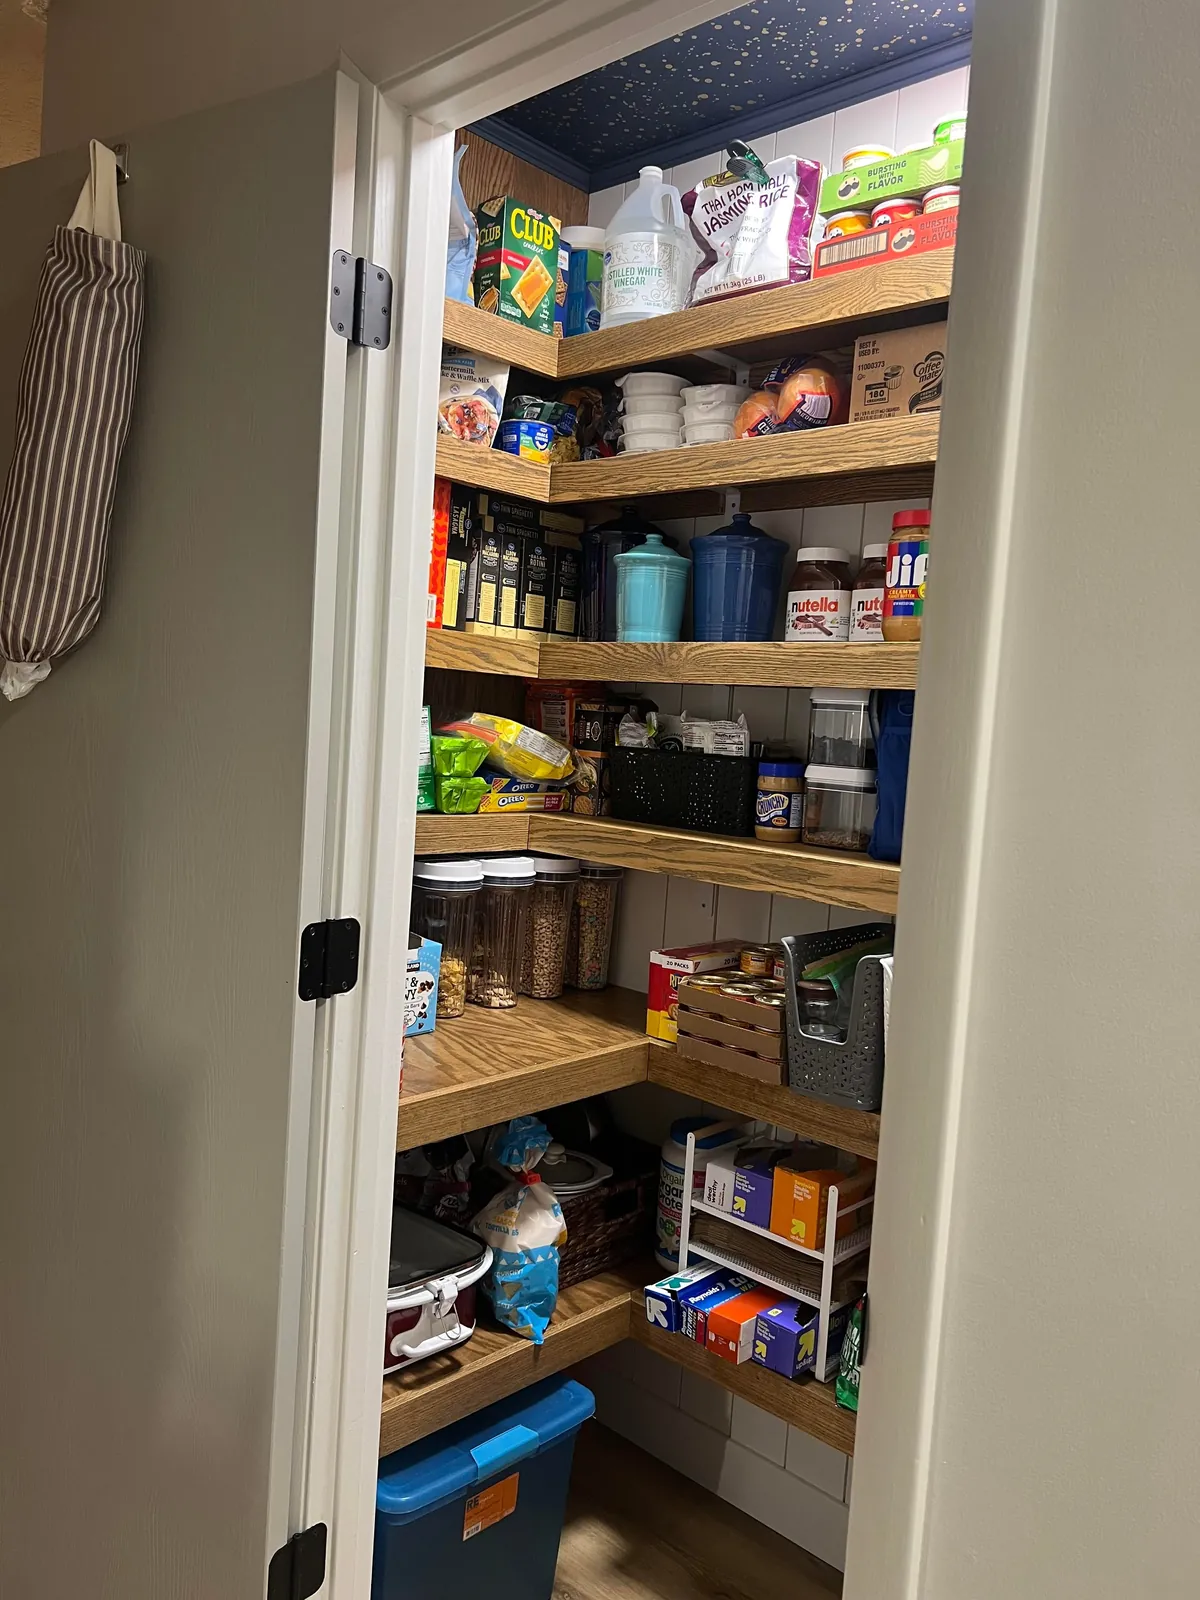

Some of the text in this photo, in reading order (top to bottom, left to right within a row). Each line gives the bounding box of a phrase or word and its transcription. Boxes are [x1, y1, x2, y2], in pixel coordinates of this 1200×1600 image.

[867, 160, 907, 177] BURSTING
[867, 175, 904, 191] FLAVOR
[878, 172, 895, 180] WITH
[701, 195, 726, 215] THAI
[726, 181, 754, 202] HOM
[703, 185, 790, 237] JASMINE RICE
[479, 225, 501, 246] CLUB
[511, 207, 554, 250] CLUB
[931, 225, 949, 233] WITH
[608, 267, 663, 281] STILLED WHITE
[613, 276, 646, 288] VINEGAR
[714, 283, 722, 292] WT
[722, 280, 742, 290] 11.3kg
[742, 277, 752, 286] (25
[753, 274, 766, 283] LB)
[859, 340, 877, 349] BEST IF
[858, 347, 880, 357] USED BY:
[858, 360, 886, 372] 11000373
[913, 361, 942, 378] Coffee
[456, 373, 477, 383] Waffle
[477, 376, 490, 384] Mix
[919, 369, 941, 383] mate
[868, 389, 885, 399] 180
[451, 505, 460, 535] LASAGNA
[511, 507, 534, 519] SPAGHETTI
[516, 527, 539, 540] SPAGHETTI
[529, 558, 546, 568] ROTINI
[791, 597, 839, 613] nutella
[511, 783, 535, 792] OREO
[498, 795, 525, 807] OREO
[757, 795, 785, 815] CRUNCHY
[674, 961, 689, 970] PACKS
[410, 976, 419, 987] &
[669, 973, 682, 987] RIT
[711, 1179, 719, 1203] worthy
[485, 1222, 510, 1236] TORTILLA
[688, 1285, 720, 1304] Reynolds
[686, 1307, 694, 1338] CUT-RITE
[697, 1312, 705, 1323] 75
[796, 1356, 813, 1370] up&up
